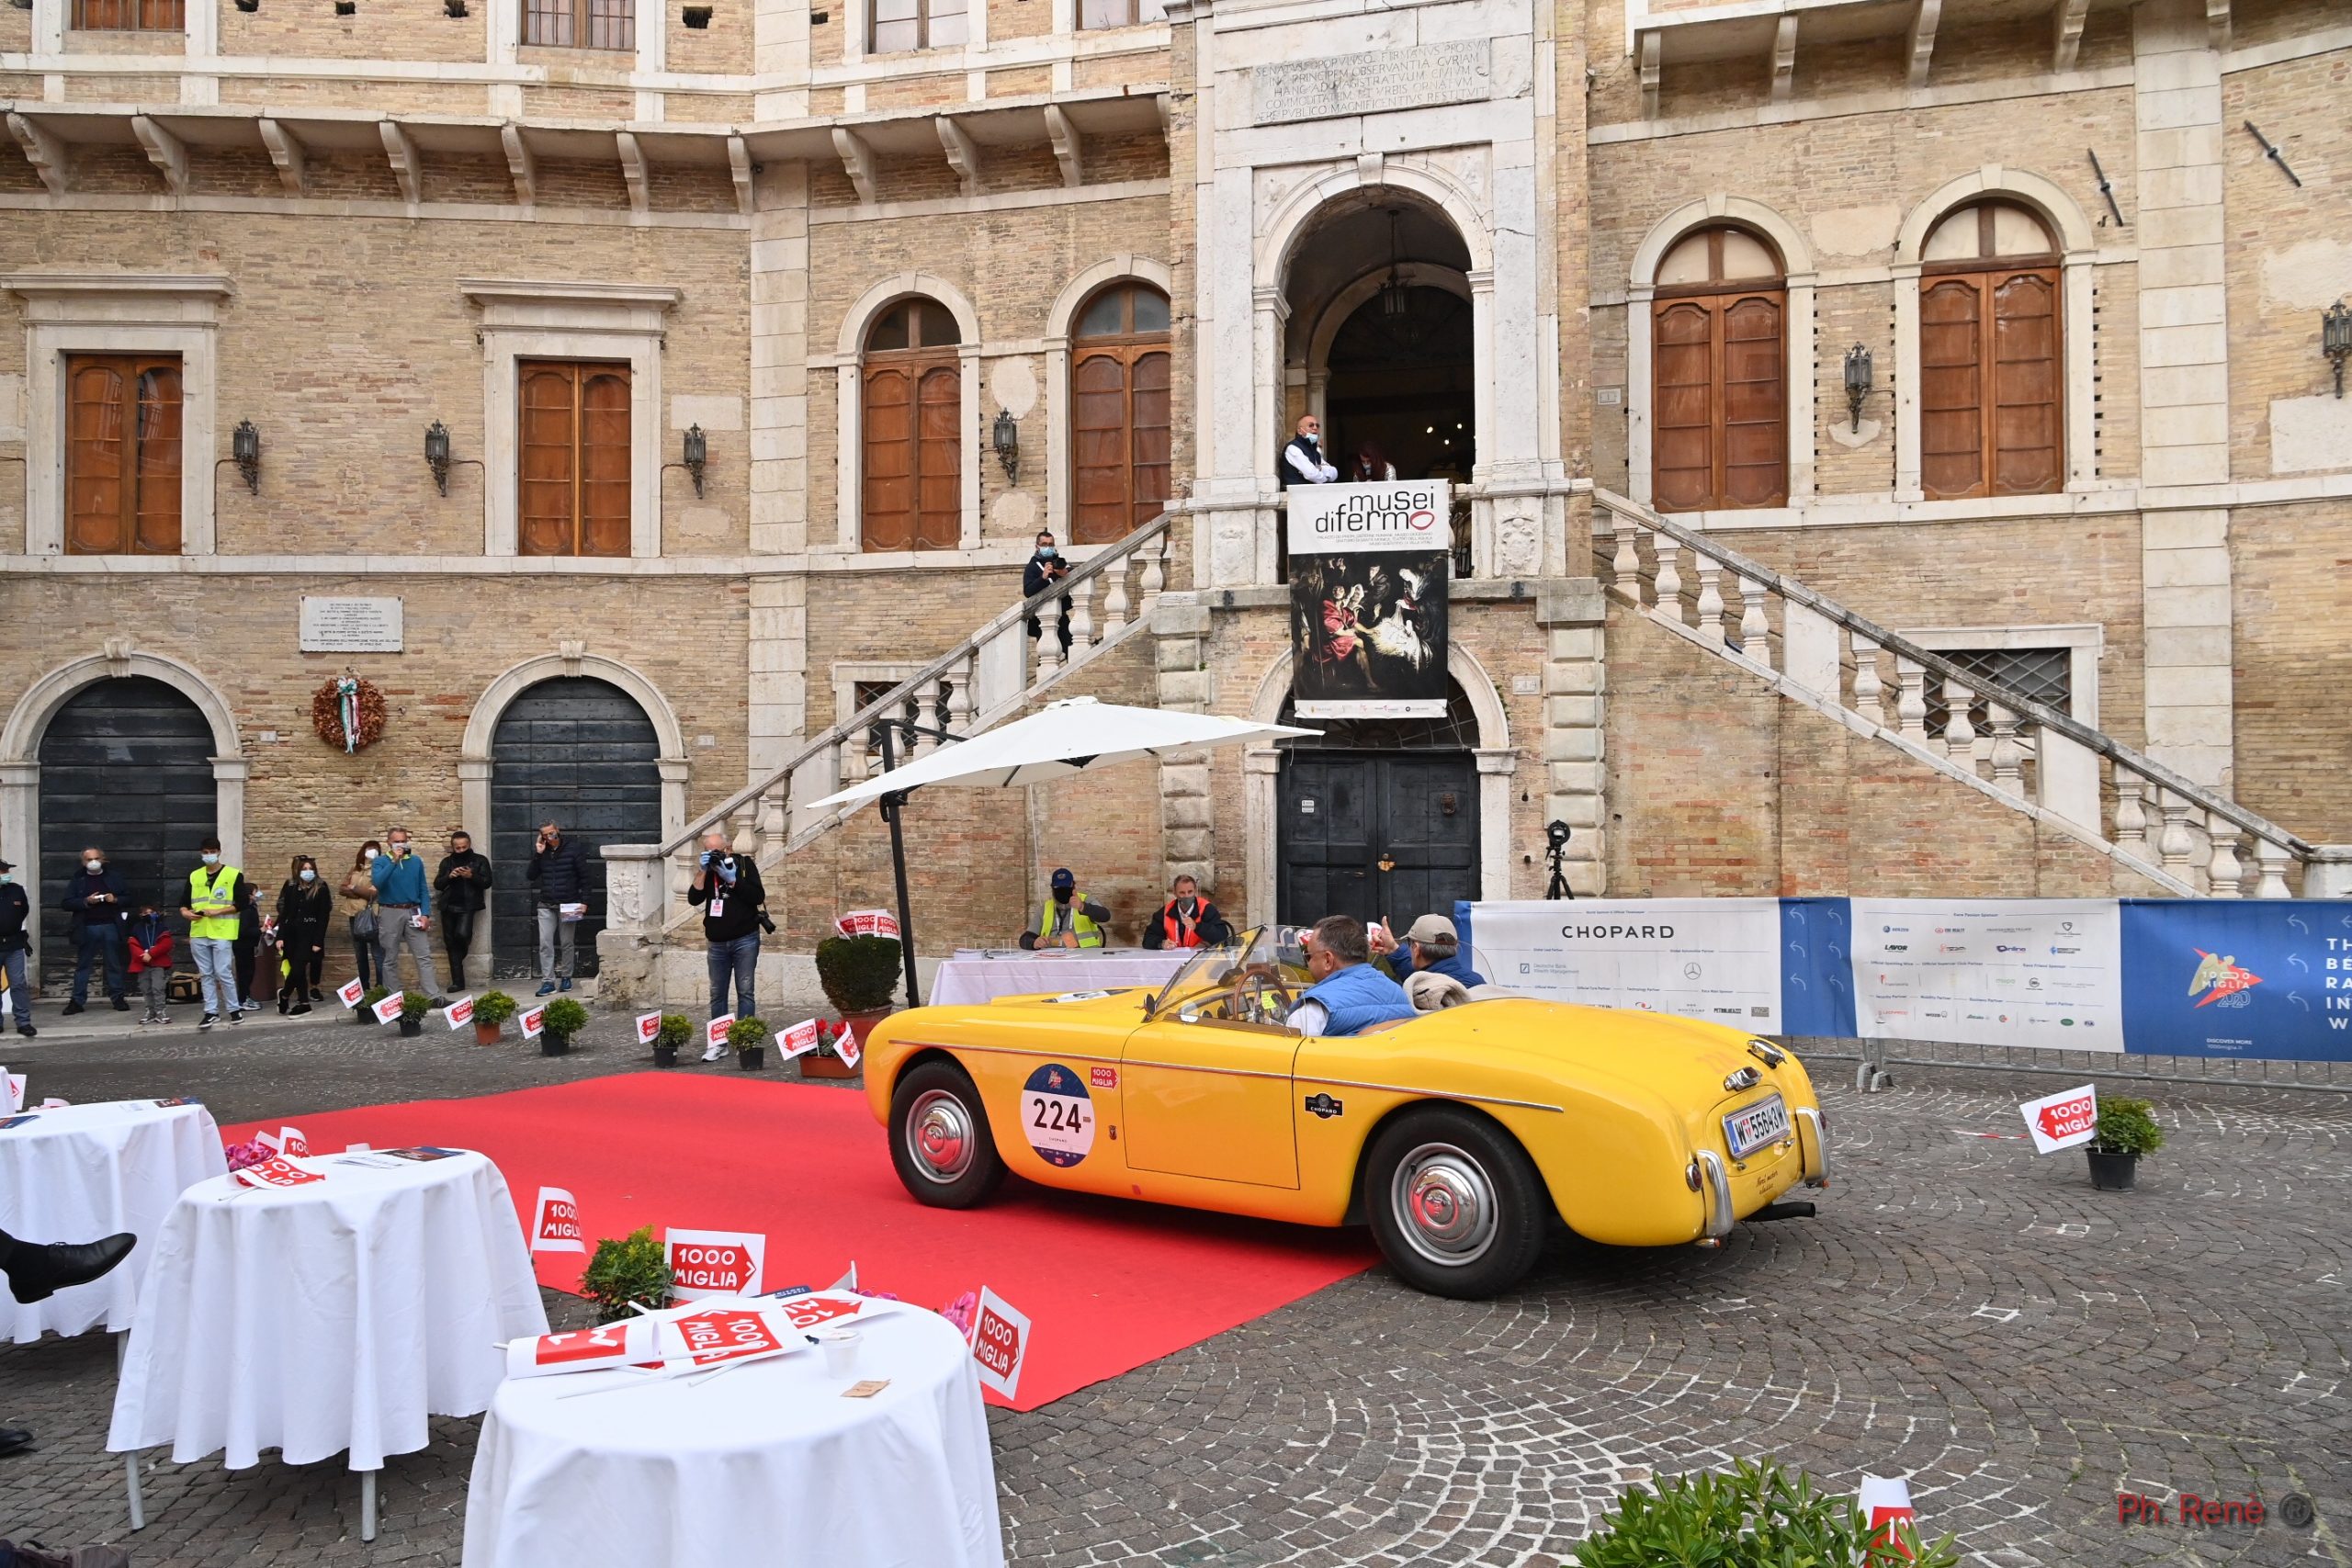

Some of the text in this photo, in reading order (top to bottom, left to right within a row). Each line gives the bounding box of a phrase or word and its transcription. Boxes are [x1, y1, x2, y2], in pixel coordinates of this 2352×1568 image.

[1351, 58, 1430, 77] OBSERVANTIA
[1282, 105, 1328, 118] PVBLICO
[1350, 486, 1434, 512] musei
[1561, 925, 1675, 939] CHOPARD
[2201, 980, 2250, 989] MIGLIA
[2217, 990, 2251, 1009] 2020
[790, 1027, 813, 1040] 1000
[1092, 1068, 1113, 1077] 1000
[1091, 1078, 1114, 1087] MIGLIA
[1033, 1098, 1082, 1134] 224
[1310, 1106, 1338, 1114] CHOPARD
[2050, 1100, 2092, 1120] 1000
[1735, 1120, 1747, 1146] W
[678, 1247, 736, 1266] 1000
[674, 1268, 738, 1288] MIGLIA
[983, 1314, 1012, 1347] 1000
[975, 1337, 1010, 1373] MIGLIA
